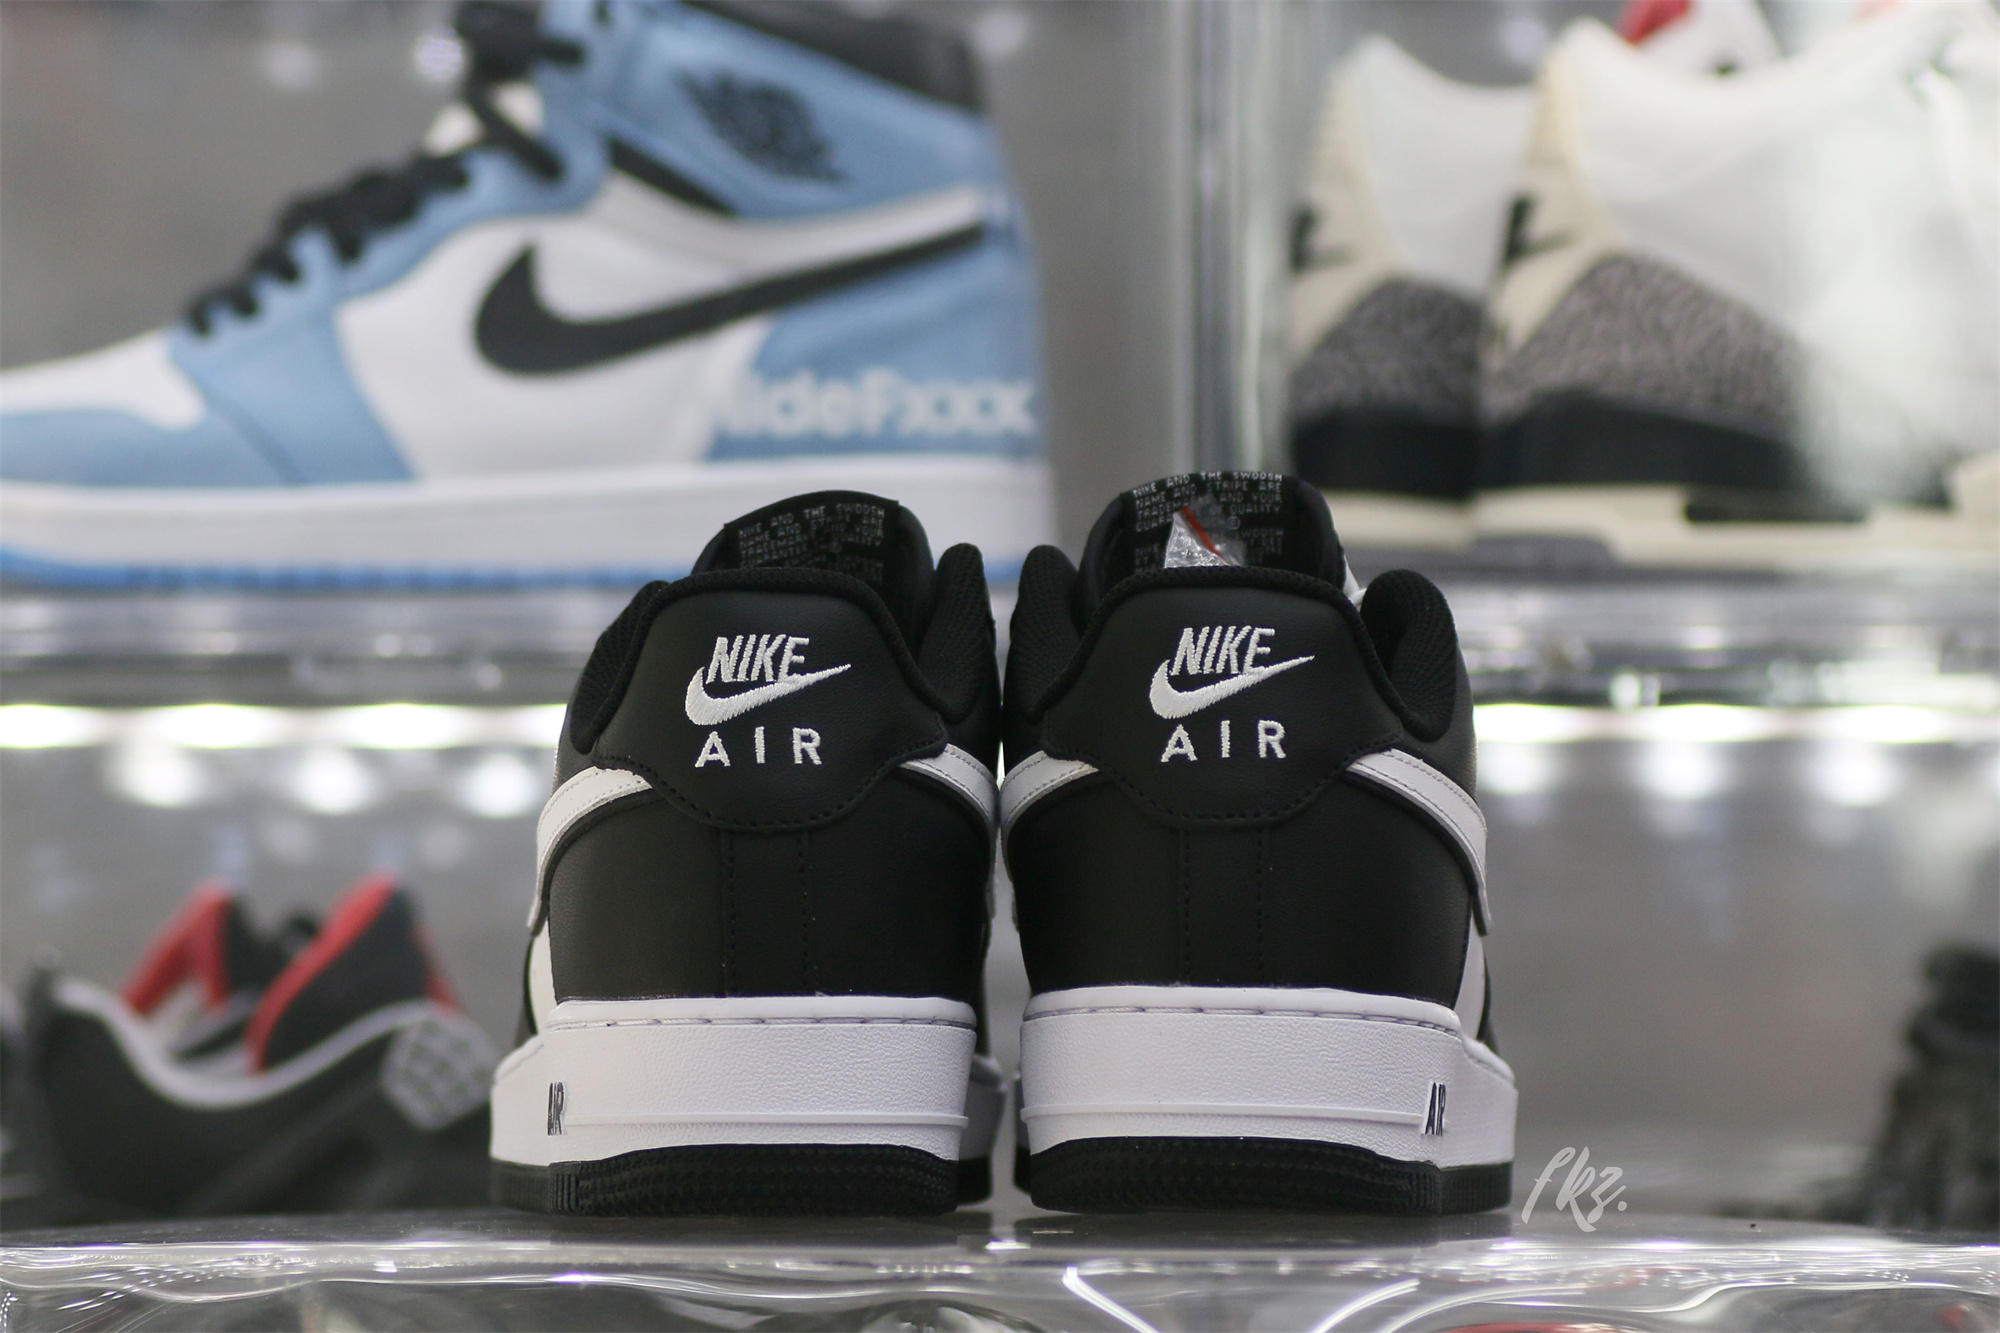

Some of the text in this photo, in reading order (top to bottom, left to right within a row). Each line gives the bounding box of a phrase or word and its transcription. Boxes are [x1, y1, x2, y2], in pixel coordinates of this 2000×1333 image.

[1133, 471, 1283, 498] NIKE AND THE SWOOSH
[1135, 480, 1282, 510] NAME AND STRIPE ARE
[1219, 491, 1244, 503] AND
[1252, 492, 1282, 504] YOUR
[738, 503, 885, 539] NIKE AND THE SWOOSH
[1230, 503, 1280, 515] QUALITY
[739, 531, 770, 548] NAME
[777, 522, 801, 537] AND
[862, 516, 883, 529] ARE
[833, 532, 881, 547] QUALITY
[855, 524, 883, 538] YOUR
[705, 634, 810, 684] NIKE
[1169, 625, 1276, 677] NIKE
[694, 725, 823, 768] AIR
[1160, 719, 1287, 763] AIR
